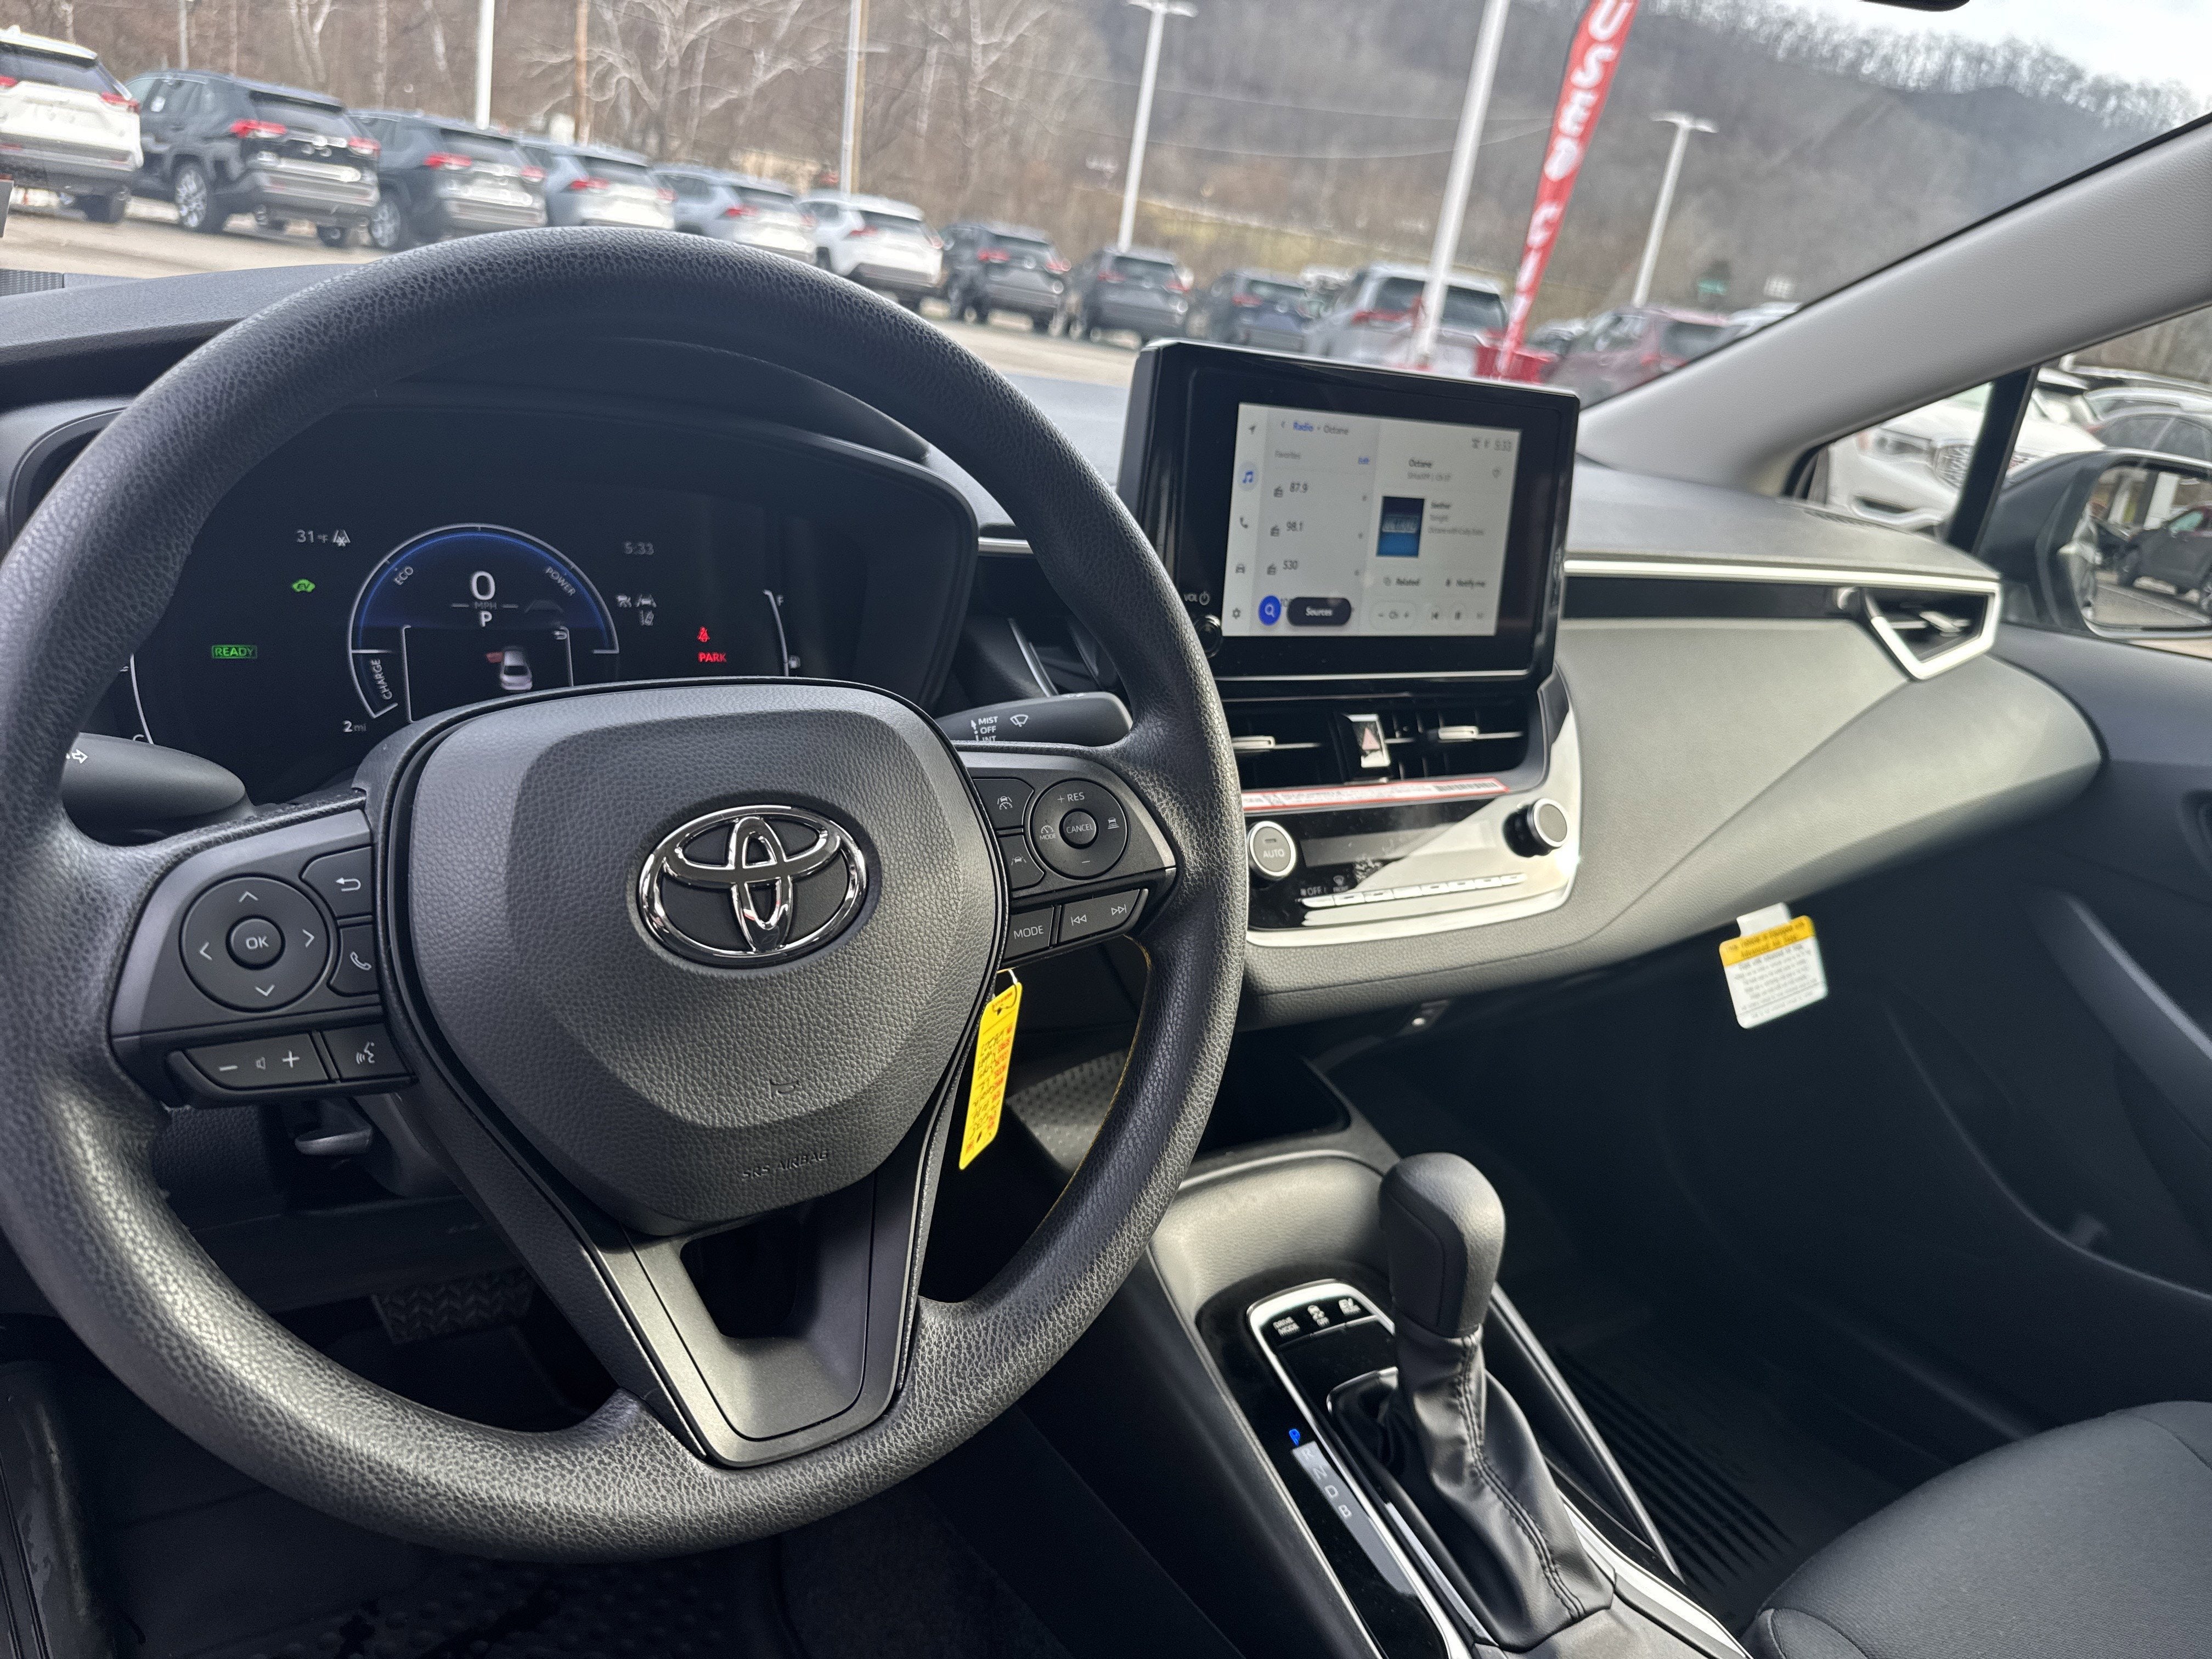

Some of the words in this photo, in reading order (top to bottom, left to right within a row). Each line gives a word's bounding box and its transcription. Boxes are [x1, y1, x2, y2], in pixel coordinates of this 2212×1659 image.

[1293, 421, 1314, 432] Radio
[1290, 481, 1308, 493] 87.9
[624, 541, 654, 555] 5:33
[1283, 559, 1299, 571] 530
[394, 565, 414, 586] ECO
[545, 566, 576, 596] POWER
[470, 570, 496, 600] 0
[776, 594, 784, 607] F
[1305, 605, 1333, 617] Sources
[480, 610, 493, 627] P
[216, 647, 255, 657] READY
[698, 651, 727, 663] PARK
[370, 659, 392, 700] CHARGE
[978, 715, 998, 725] MIST
[980, 725, 997, 734] OFF
[1067, 792, 1085, 802] RES
[1066, 823, 1093, 834] CANCEL
[1039, 833, 1057, 841] MODE
[1262, 848, 1285, 859] AUTO
[1013, 925, 1044, 940] MODE
[245, 935, 269, 950] OK
[742, 1165, 769, 1181] SRS
[777, 1150, 830, 1171] AIRBAG
[1289, 1428, 1301, 1448] P
[1301, 1448, 1314, 1461] R
[1313, 1465, 1328, 1480] N
[1324, 1485, 1339, 1499] D
[1338, 1504, 1353, 1518] B
